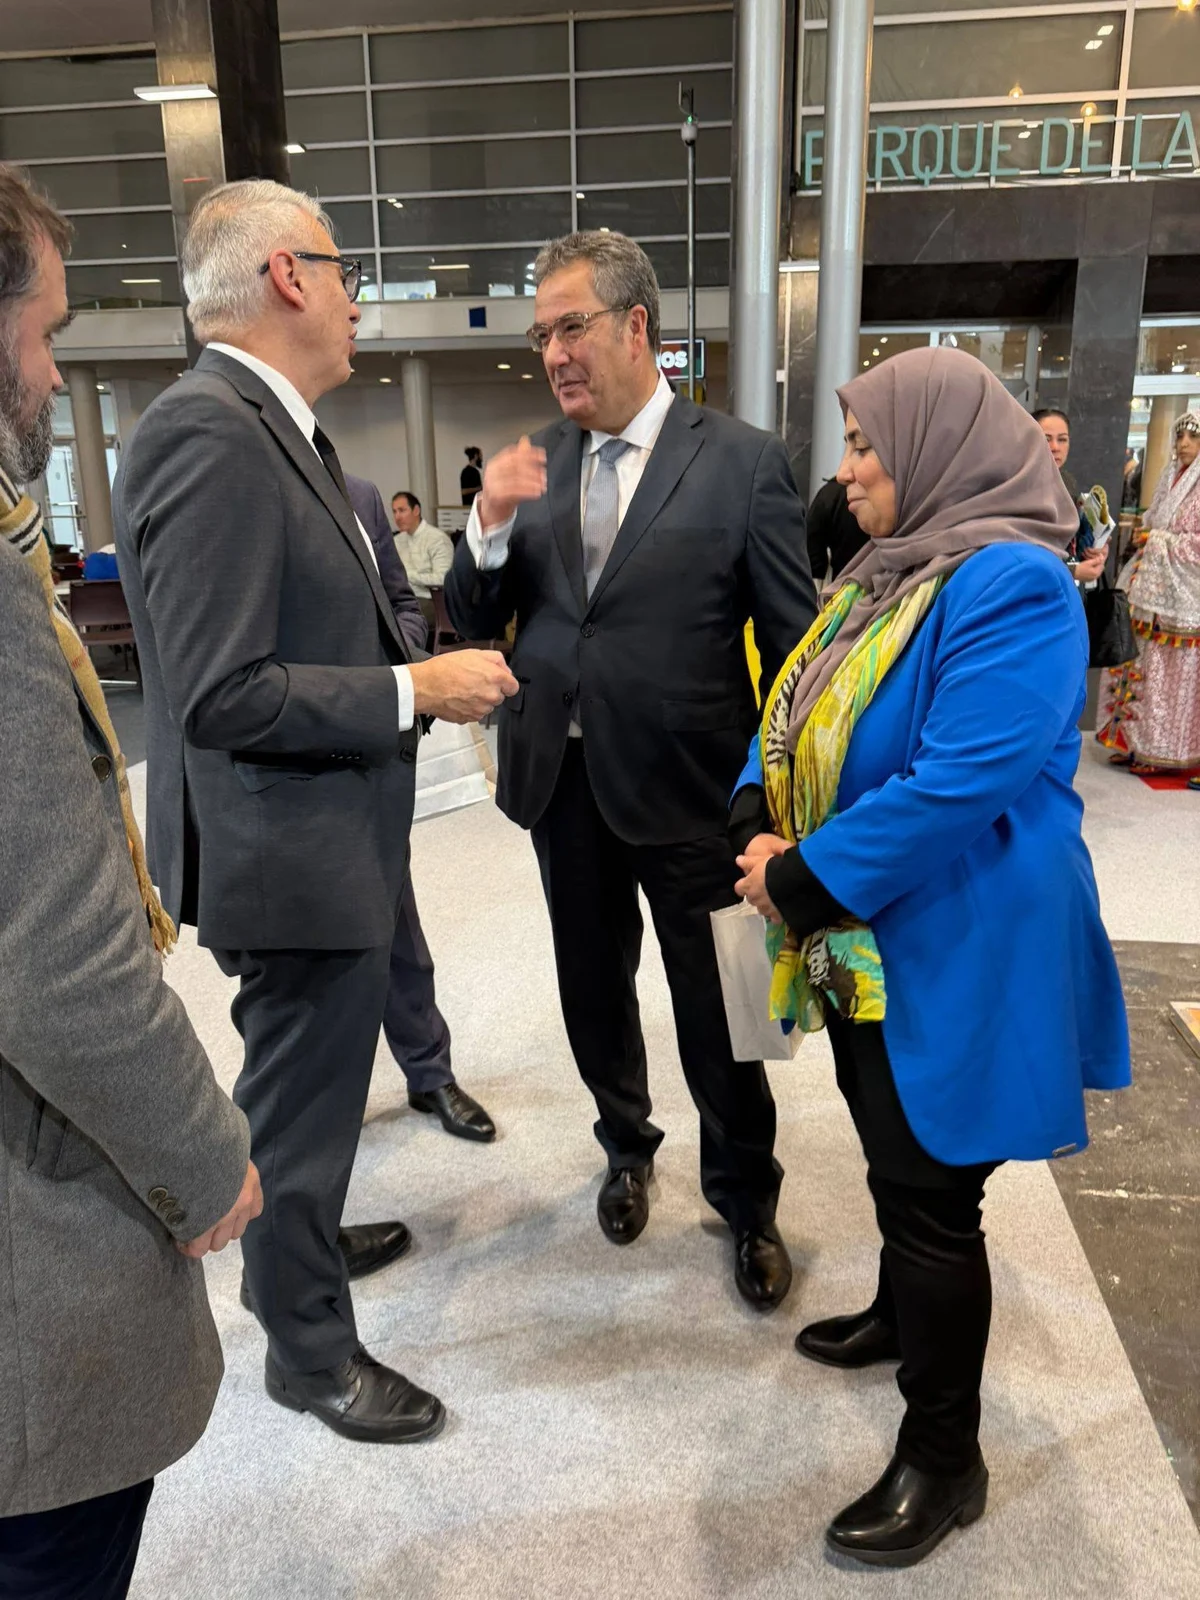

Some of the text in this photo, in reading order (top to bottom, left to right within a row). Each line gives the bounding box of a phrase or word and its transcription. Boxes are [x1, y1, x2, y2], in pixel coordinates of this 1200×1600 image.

[804, 110, 1200, 188] PRQUE DE LA
